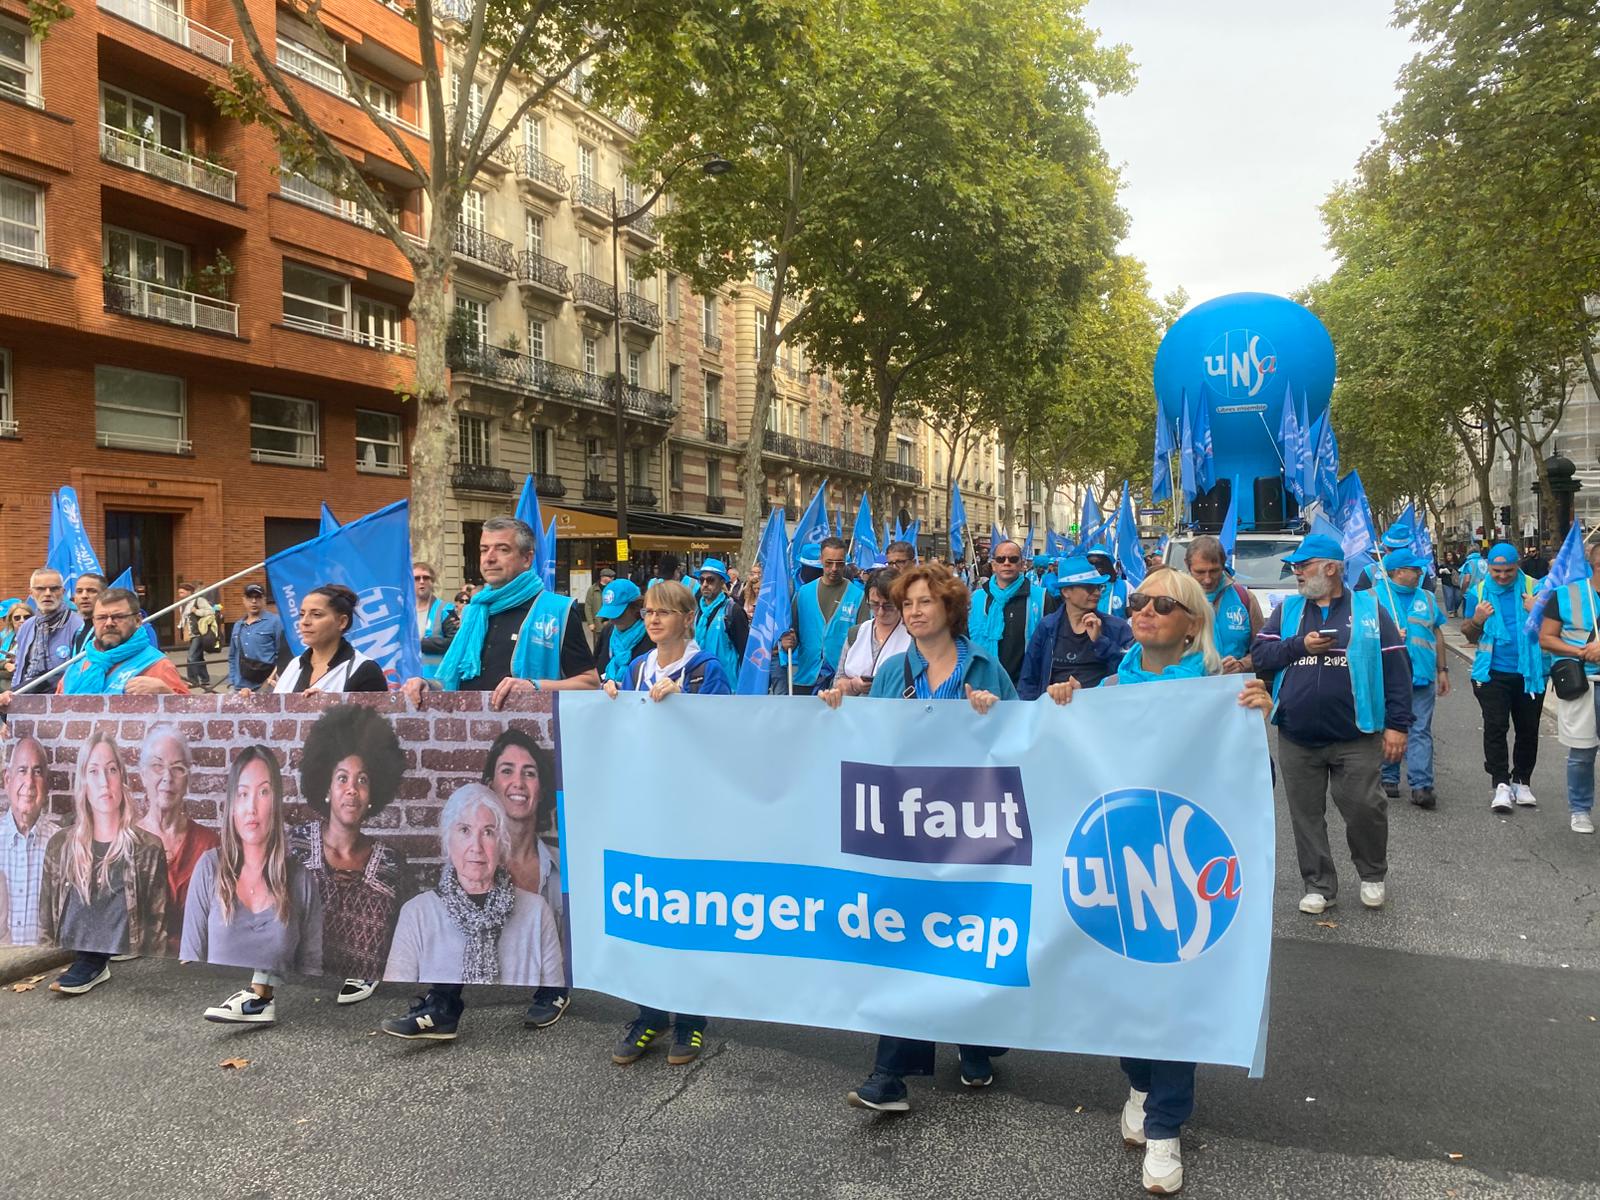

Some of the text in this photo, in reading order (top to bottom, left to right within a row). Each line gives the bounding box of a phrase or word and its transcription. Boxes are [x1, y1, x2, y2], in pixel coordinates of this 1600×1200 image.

[282, 584, 299, 618] Mon
[855, 783, 1024, 839] Il faut
[611, 874, 1018, 969] changer de cap
